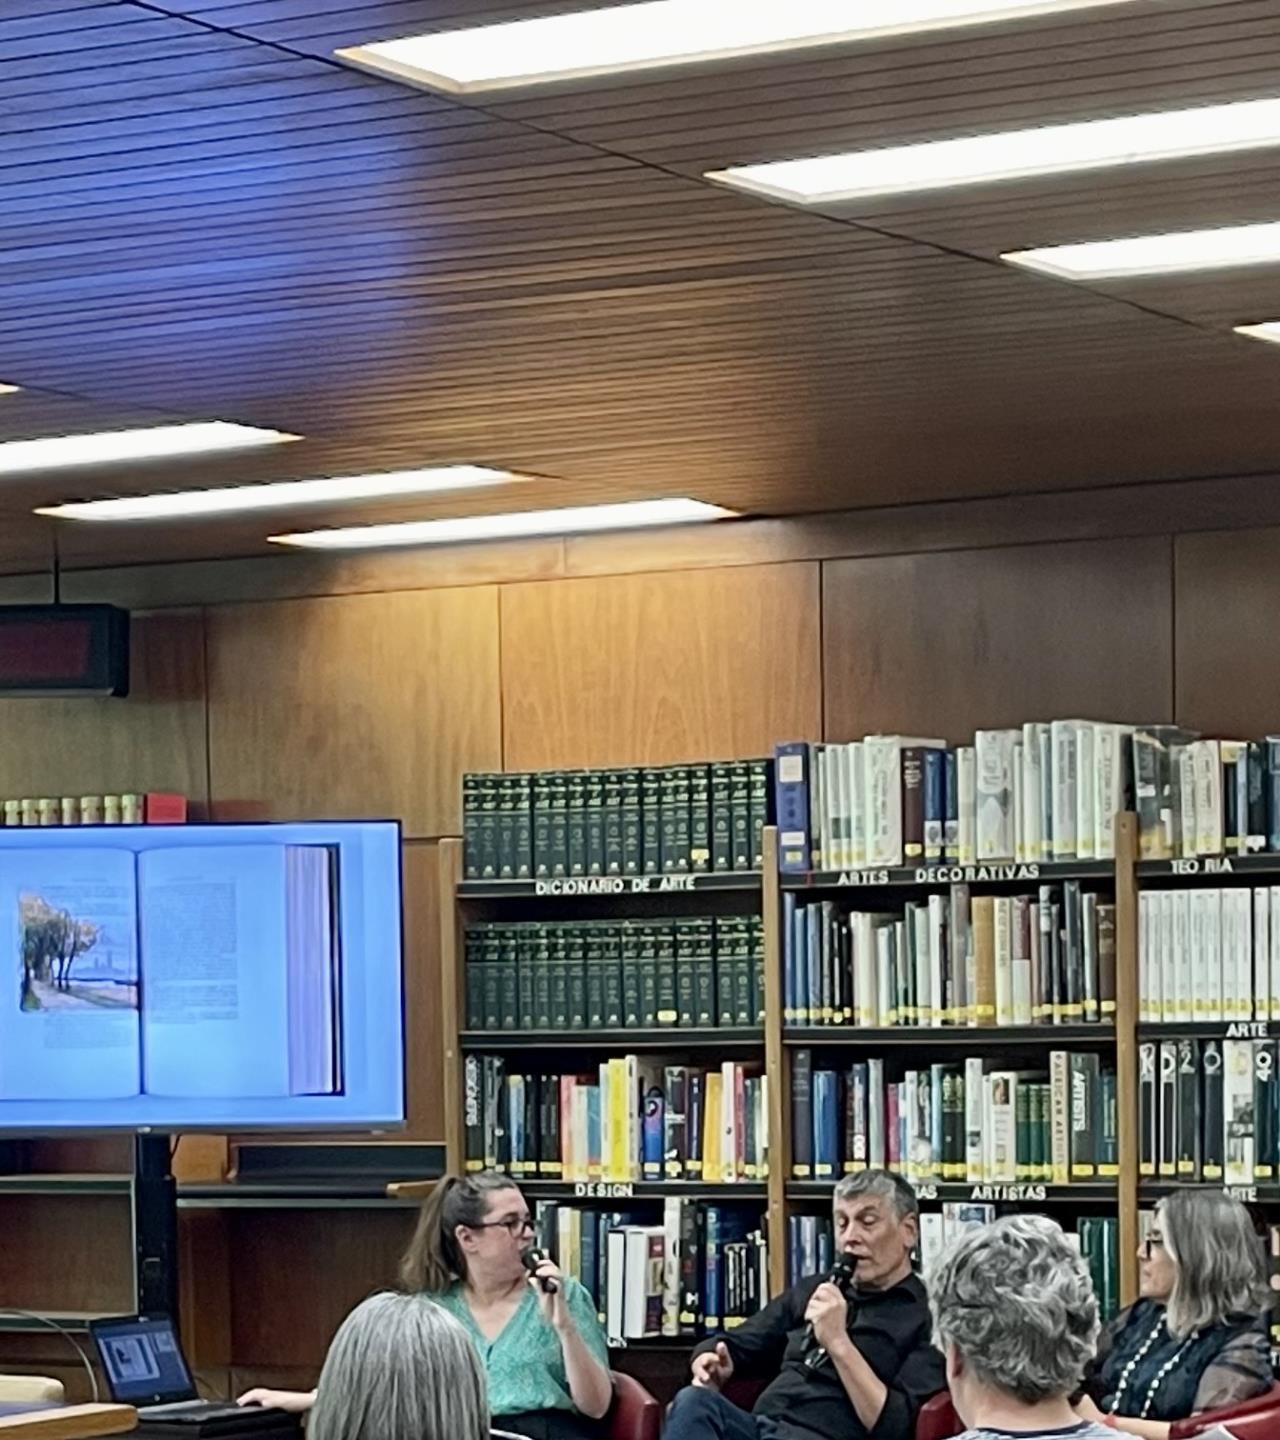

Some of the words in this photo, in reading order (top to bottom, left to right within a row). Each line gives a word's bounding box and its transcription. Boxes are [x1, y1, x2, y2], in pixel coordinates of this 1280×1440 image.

[838, 869, 889, 885] ARTES
[916, 864, 1039, 883] DECORATIVAS
[535, 877, 624, 895] DICIONARIO
[632, 878, 650, 893] DE
[659, 876, 696, 892] ARTE
[1227, 1022, 1268, 1037] ARTE
[1073, 1070, 1086, 1131] ARTISTS
[575, 1184, 634, 1198] DESIGN
[971, 1185, 1046, 1201] ARTISTAS
